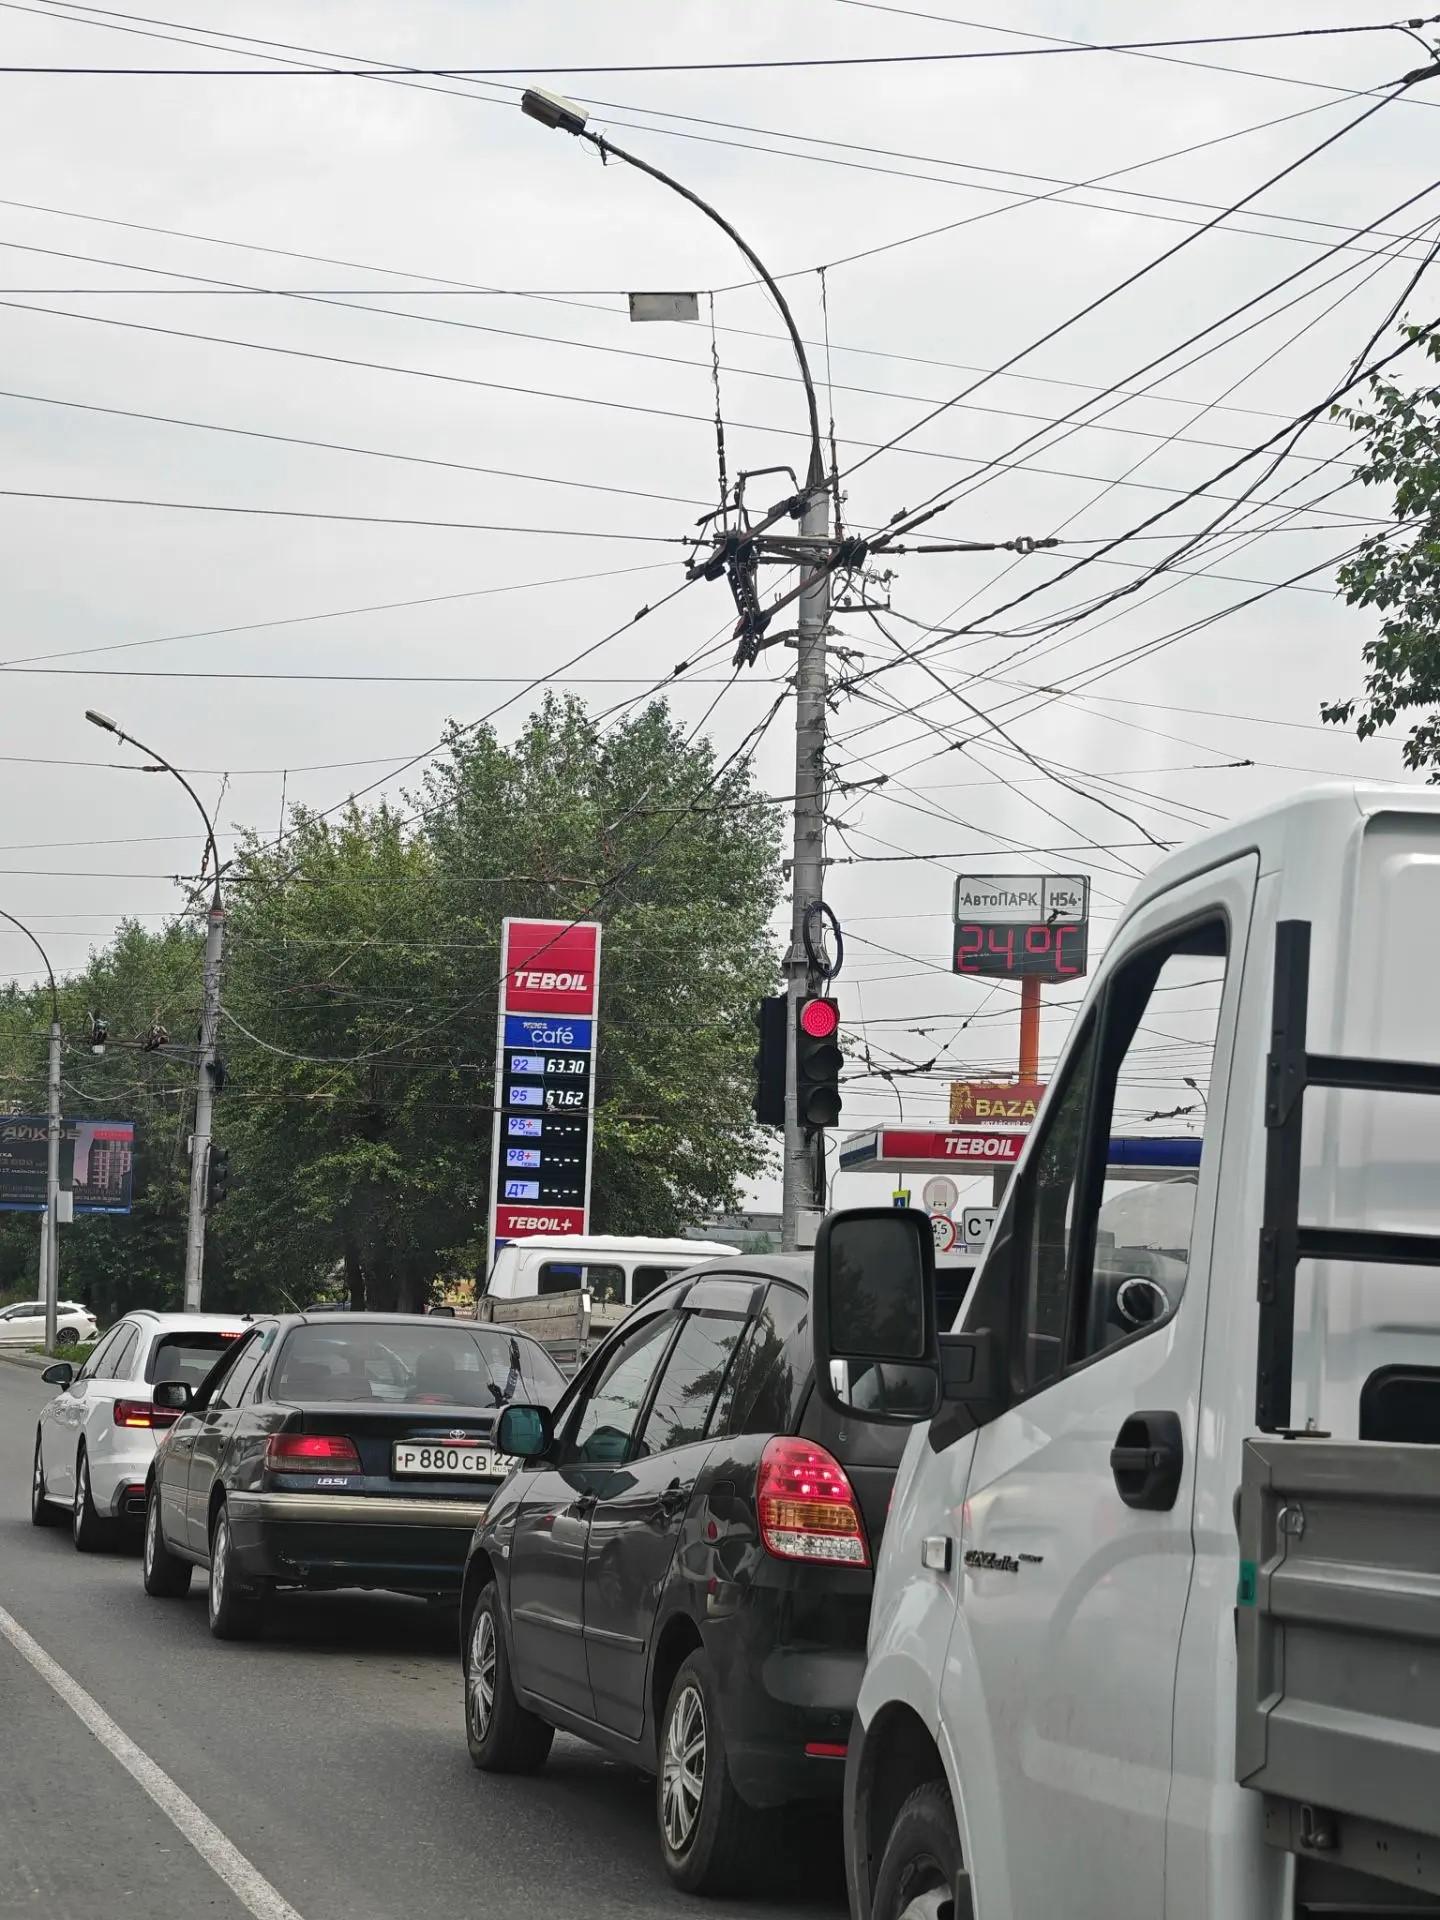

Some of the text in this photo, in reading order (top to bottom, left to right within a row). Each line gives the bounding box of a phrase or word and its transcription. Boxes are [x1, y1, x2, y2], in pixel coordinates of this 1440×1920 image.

[514, 971, 588, 991] TEBOIL
[531, 1026, 574, 1045] café
[512, 1058, 585, 1074] 92 63.30
[511, 1089, 528, 1101] 95
[510, 1119, 533, 1130] 95+
[944, 1137, 1016, 1156] TEBOIL
[508, 1149, 532, 1161] 98+
[507, 1184, 529, 1197] ДТ
[508, 1216, 573, 1231] TEBOIL+
